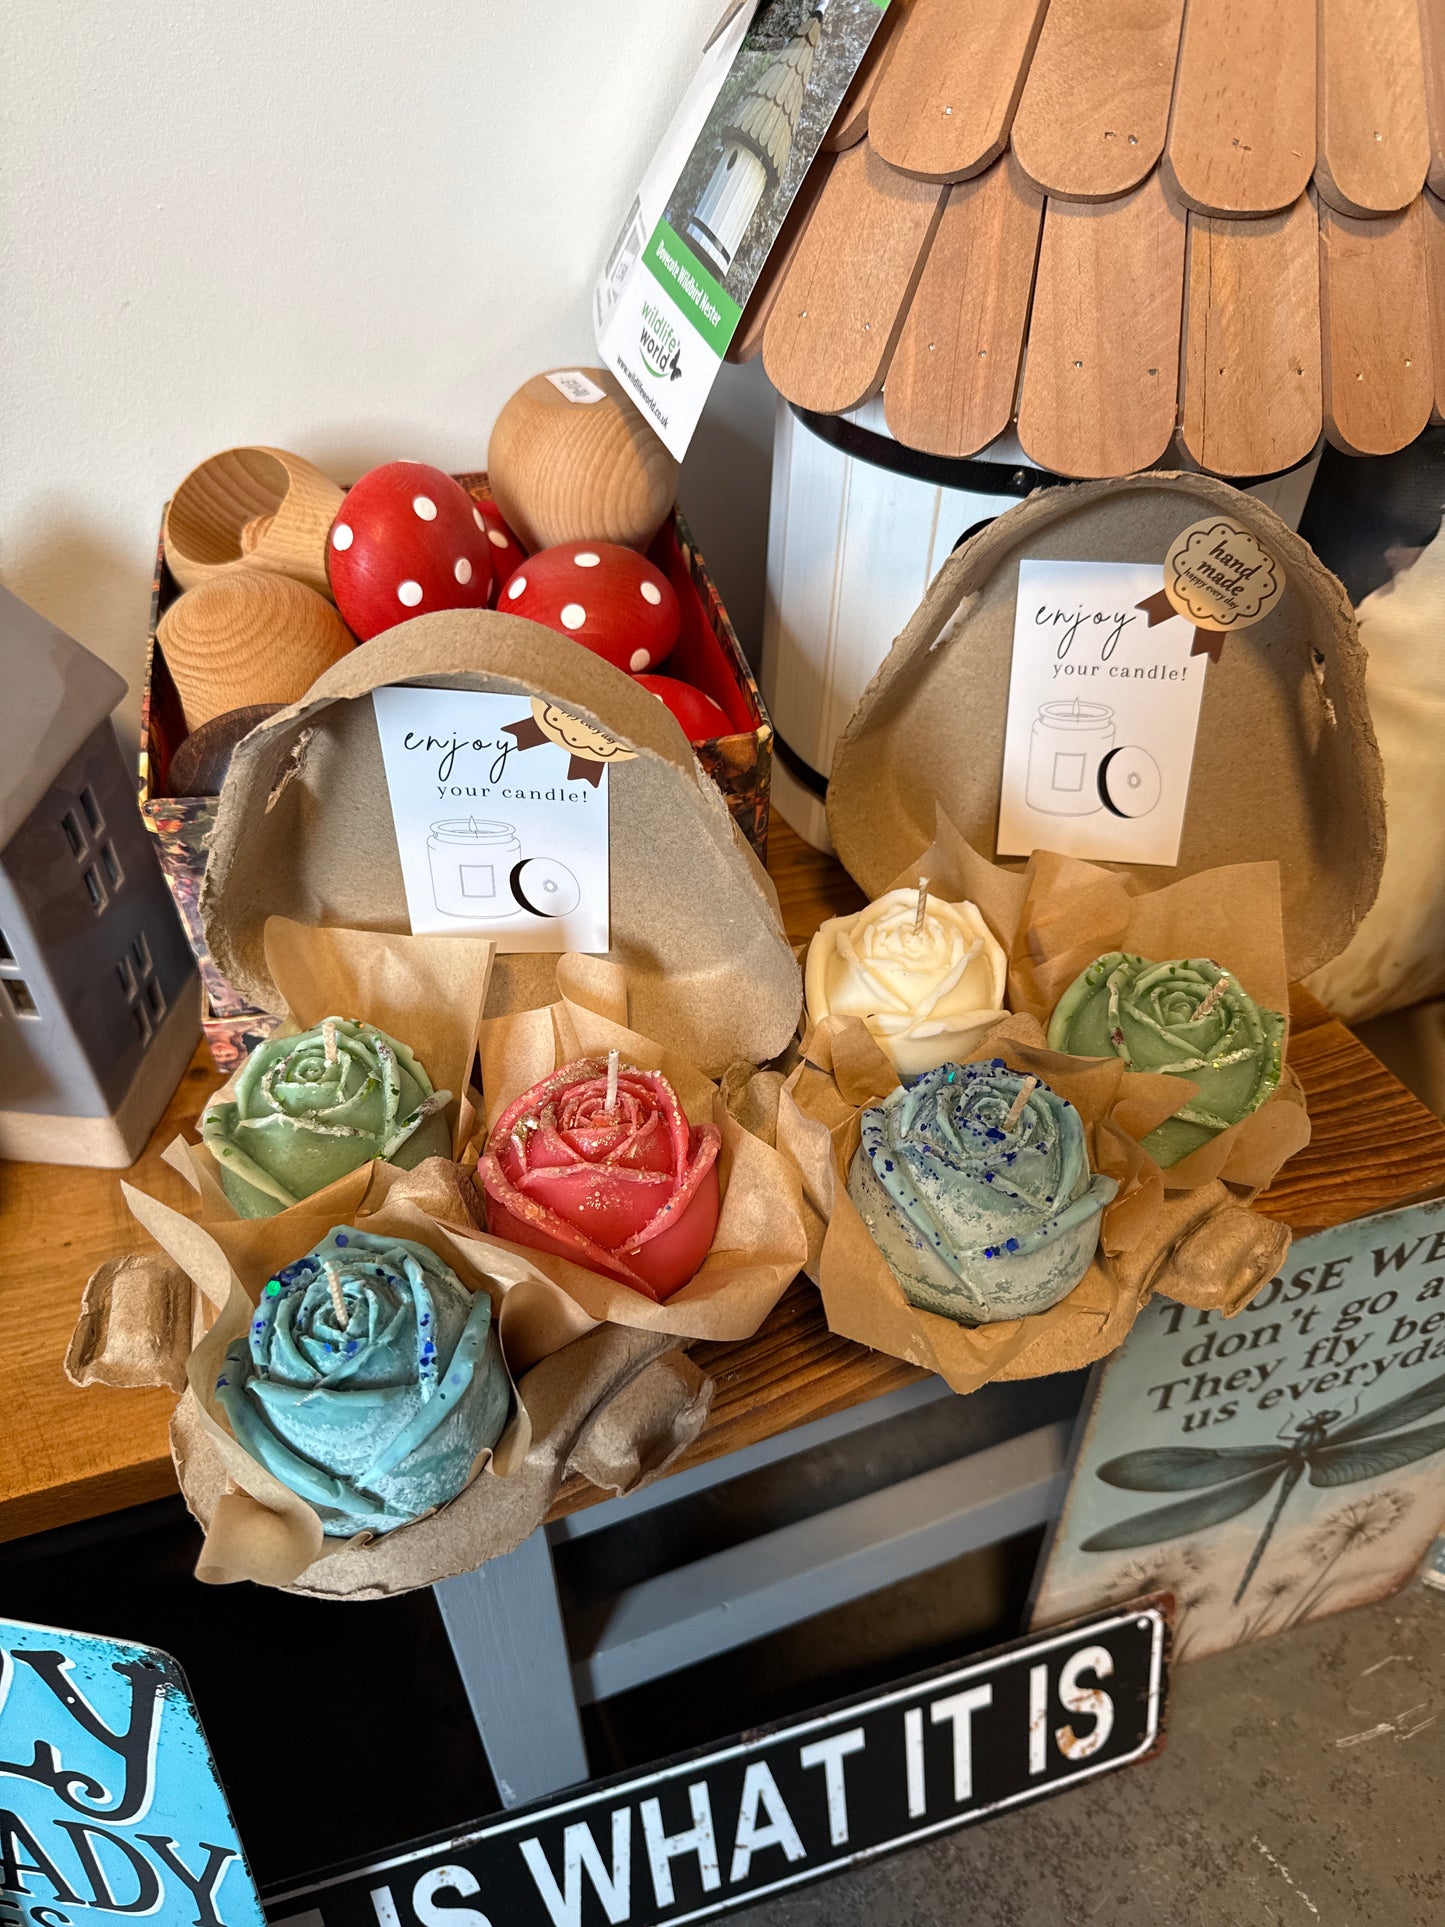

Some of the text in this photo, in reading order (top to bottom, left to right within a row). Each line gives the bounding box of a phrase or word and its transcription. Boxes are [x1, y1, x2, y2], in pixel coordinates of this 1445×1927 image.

[656, 239, 721, 327] Dovecote Wildbird Nester
[639, 327, 671, 372] world
[641, 301, 677, 353] wildlife
[616, 354, 669, 430] www.wildlifeworld.co.uk
[1196, 561, 1245, 597] made
[1208, 540, 1263, 581] hand
[1183, 567, 1239, 611] happy every day
[1035, 604, 1137, 661] enjoy
[1052, 663, 1188, 682] your candle!
[404, 731, 518, 785] enjoy
[436, 785, 588, 803] your candle!
[1158, 1256, 1353, 1337] TOSE
[1181, 1304, 1321, 1368] don't
[1333, 1290, 1398, 1333] go
[1147, 1357, 1287, 1413] They
[1298, 1332, 1375, 1371] fly
[1181, 1400, 1239, 1433] us
[518, 1727, 866, 1927] WHAT
[904, 1682, 993, 1820] IT
[1028, 1645, 1115, 1776] IS
